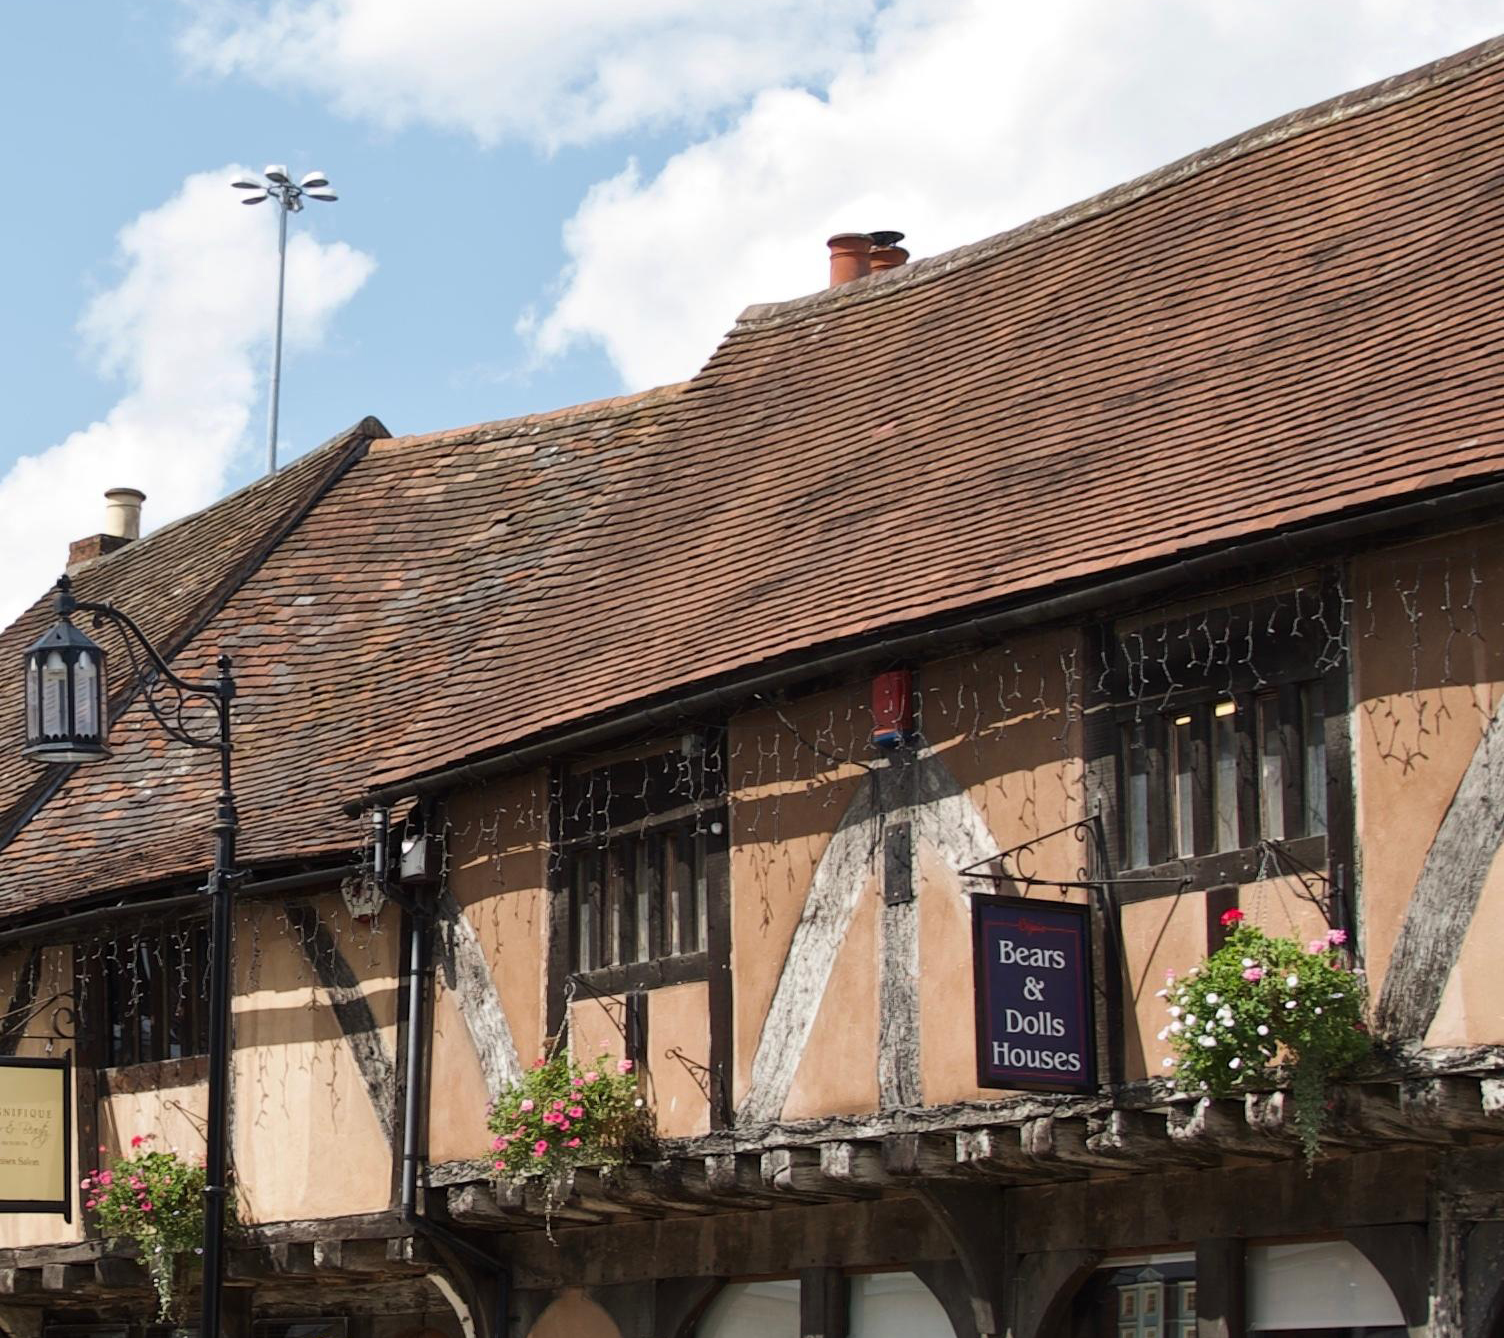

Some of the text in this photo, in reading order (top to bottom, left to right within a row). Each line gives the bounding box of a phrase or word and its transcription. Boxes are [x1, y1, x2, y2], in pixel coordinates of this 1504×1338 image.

[998, 939, 1066, 969] Bears
[1023, 976, 1045, 1001] &
[1004, 1008, 1066, 1037] Dolls
[991, 1040, 1081, 1072] Houses
